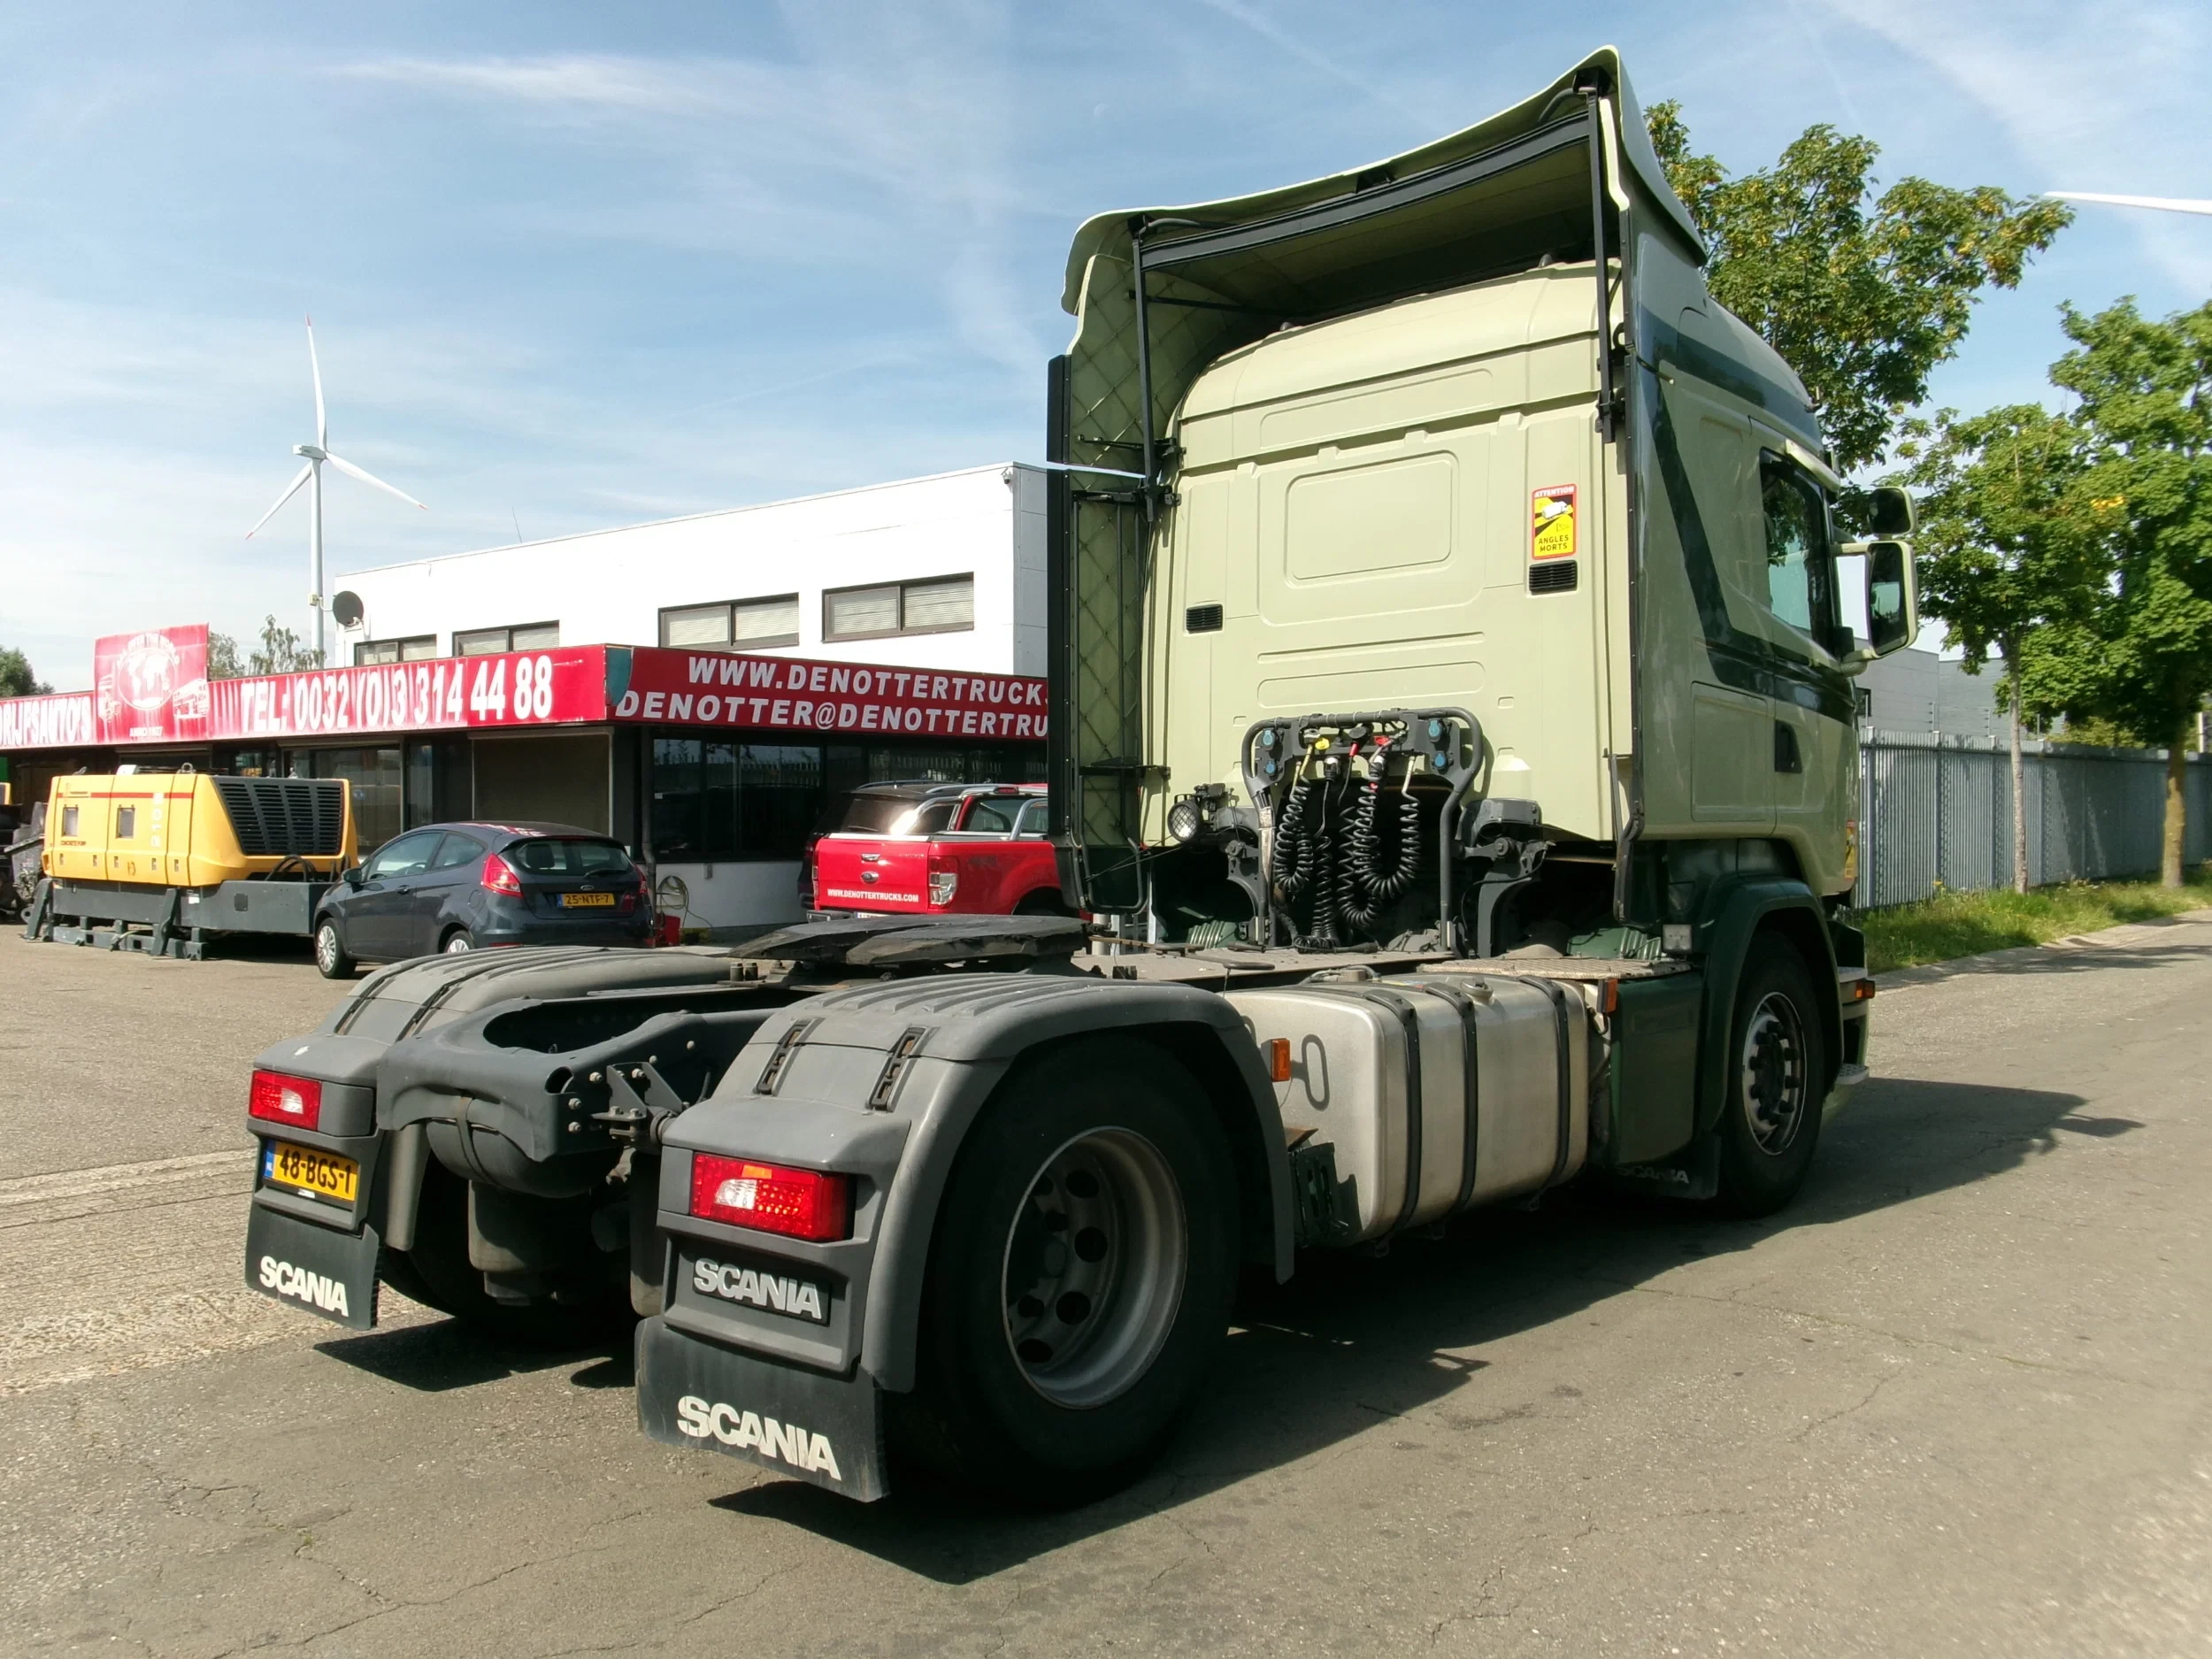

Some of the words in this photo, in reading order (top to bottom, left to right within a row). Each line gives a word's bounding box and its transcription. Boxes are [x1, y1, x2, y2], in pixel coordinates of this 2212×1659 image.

[1534, 486, 1575, 498] ATTENTION
[1539, 534, 1569, 545] ANGLES
[1540, 542, 1568, 552] MORTS
[294, 676, 349, 732] 0032
[415, 663, 465, 724] 314
[470, 658, 506, 720] 44
[513, 655, 553, 720] 88
[687, 656, 1048, 706] WWW.DENOTTERTRUCK
[0, 695, 91, 748] RIJFSAUTO'S
[566, 895, 610, 905] 25-NTF-7
[827, 887, 919, 903] WWW.DENOTTERTRUCKS.COM
[280, 1148, 352, 1195] 48-BGS-1
[259, 1255, 349, 1317] SCANIA
[694, 1257, 822, 1319] SCANIA
[677, 1394, 842, 1481] SCANIA
